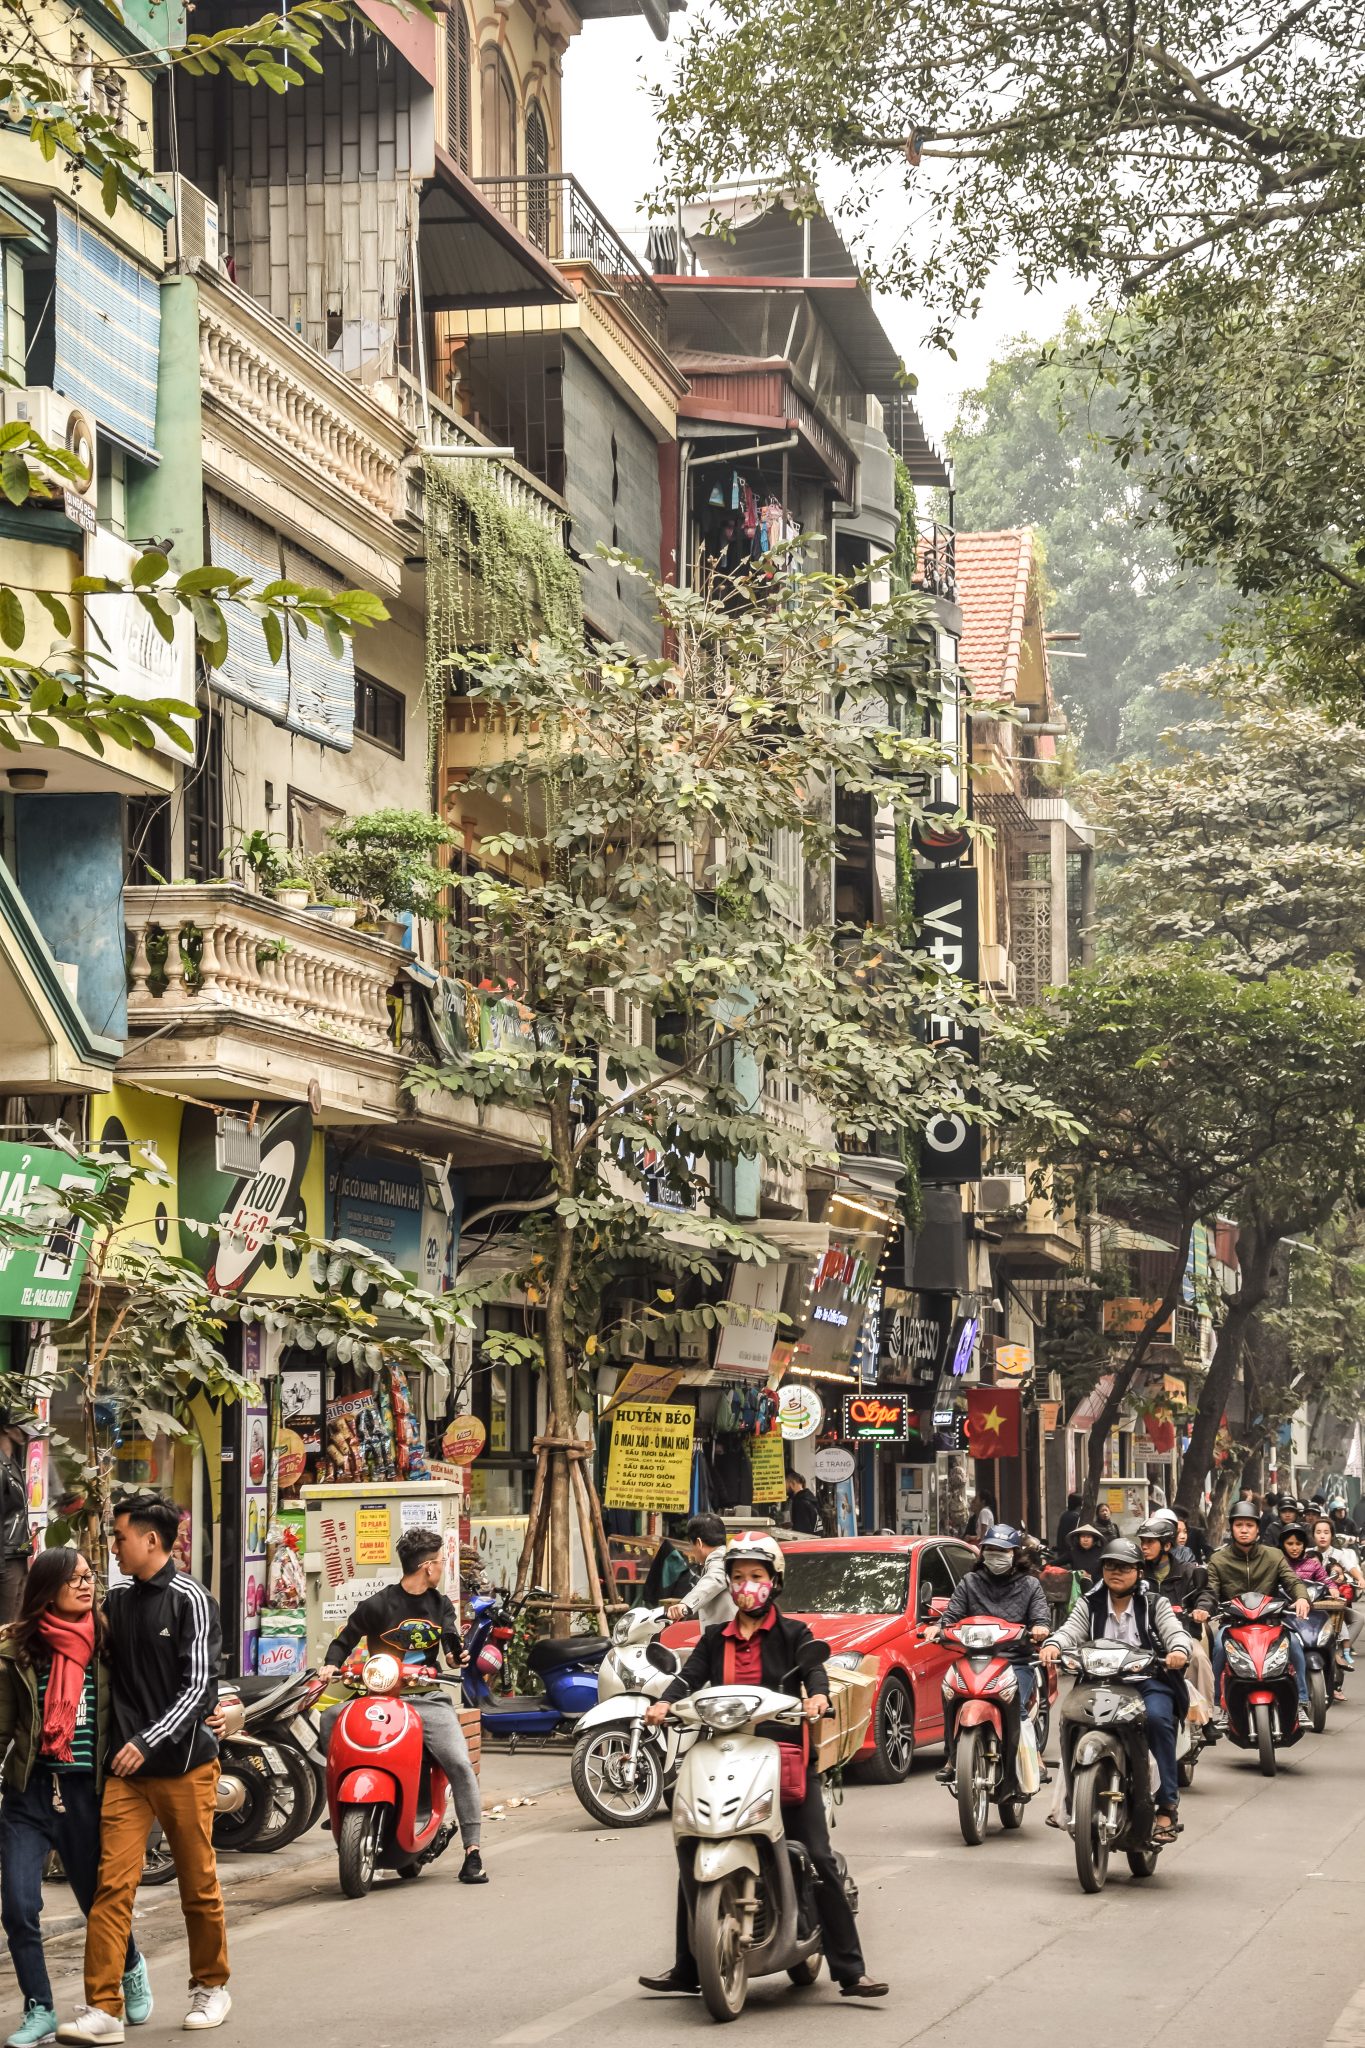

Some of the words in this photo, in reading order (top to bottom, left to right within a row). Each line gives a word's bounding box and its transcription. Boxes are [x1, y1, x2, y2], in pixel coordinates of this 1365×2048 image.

[923, 899, 966, 1153] VPEO
[380, 1180, 408, 1206] THANH
[326, 1396, 375, 1421] HIROSHI
[666, 1410, 691, 1425] BÉO
[850, 1400, 900, 1428] Spa
[621, 1434, 634, 1446] MAI
[661, 1436, 674, 1449] MAI
